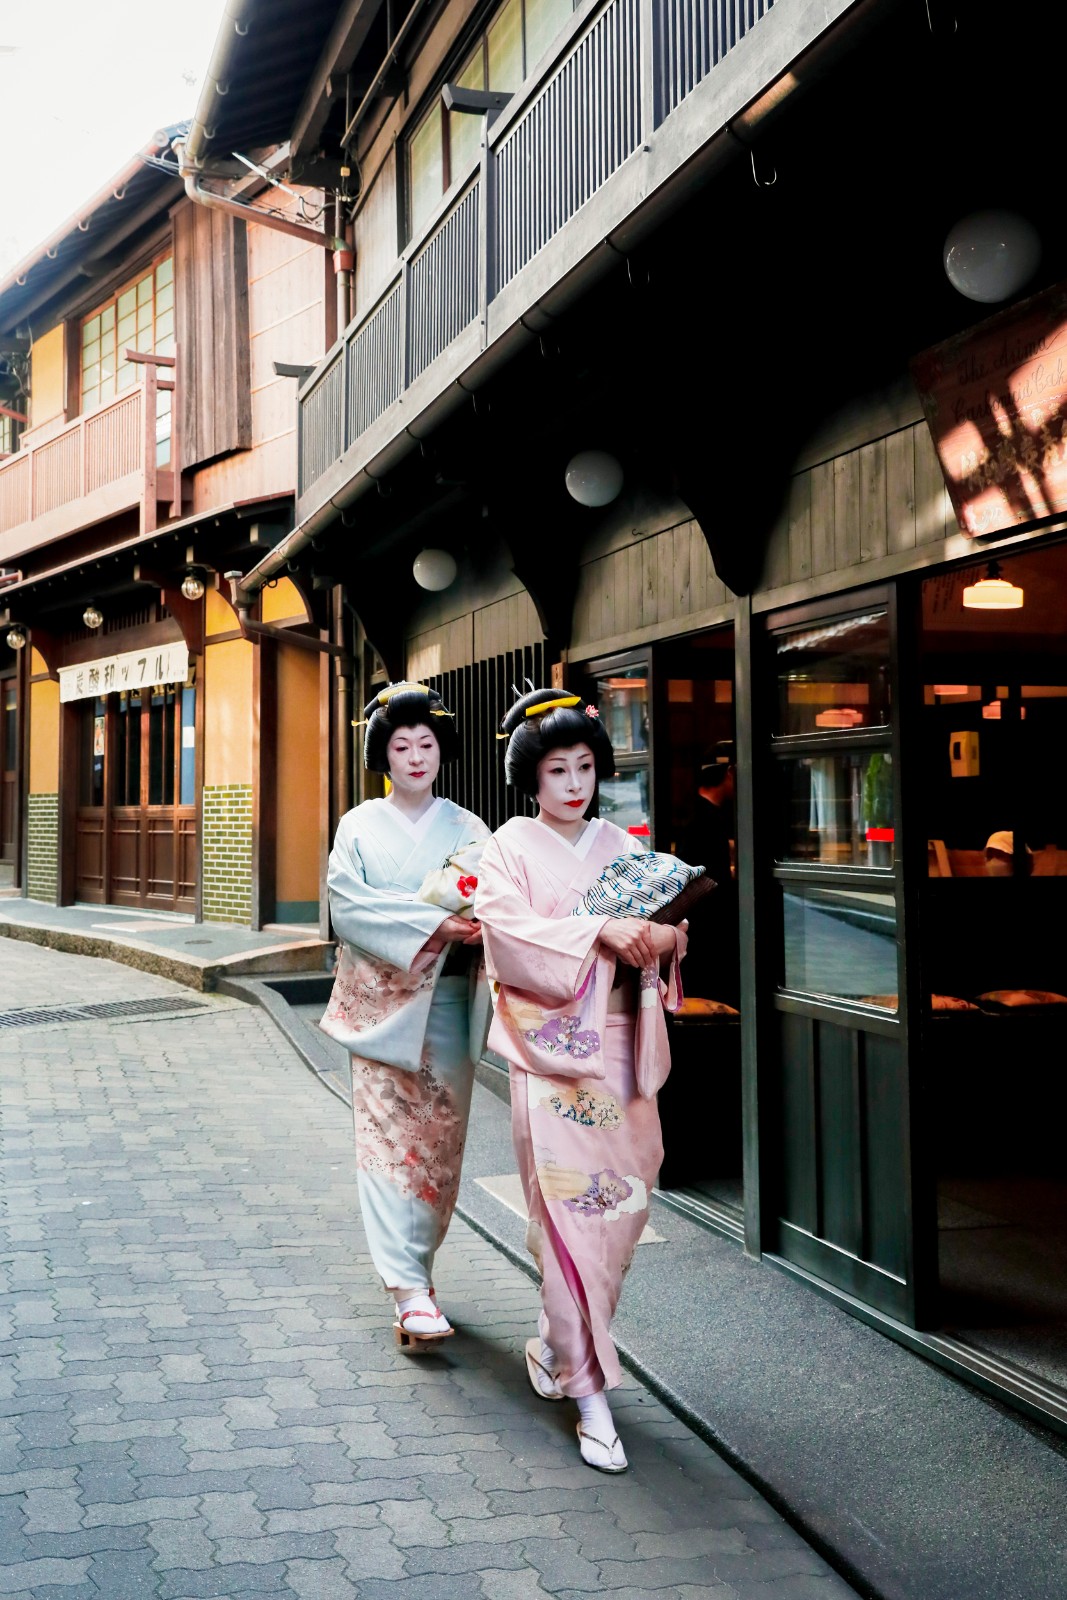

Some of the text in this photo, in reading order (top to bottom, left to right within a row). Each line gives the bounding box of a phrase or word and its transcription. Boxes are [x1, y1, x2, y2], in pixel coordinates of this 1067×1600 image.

[956, 337, 1047, 385] The Arima
[1031, 358, 1067, 394] Cak
